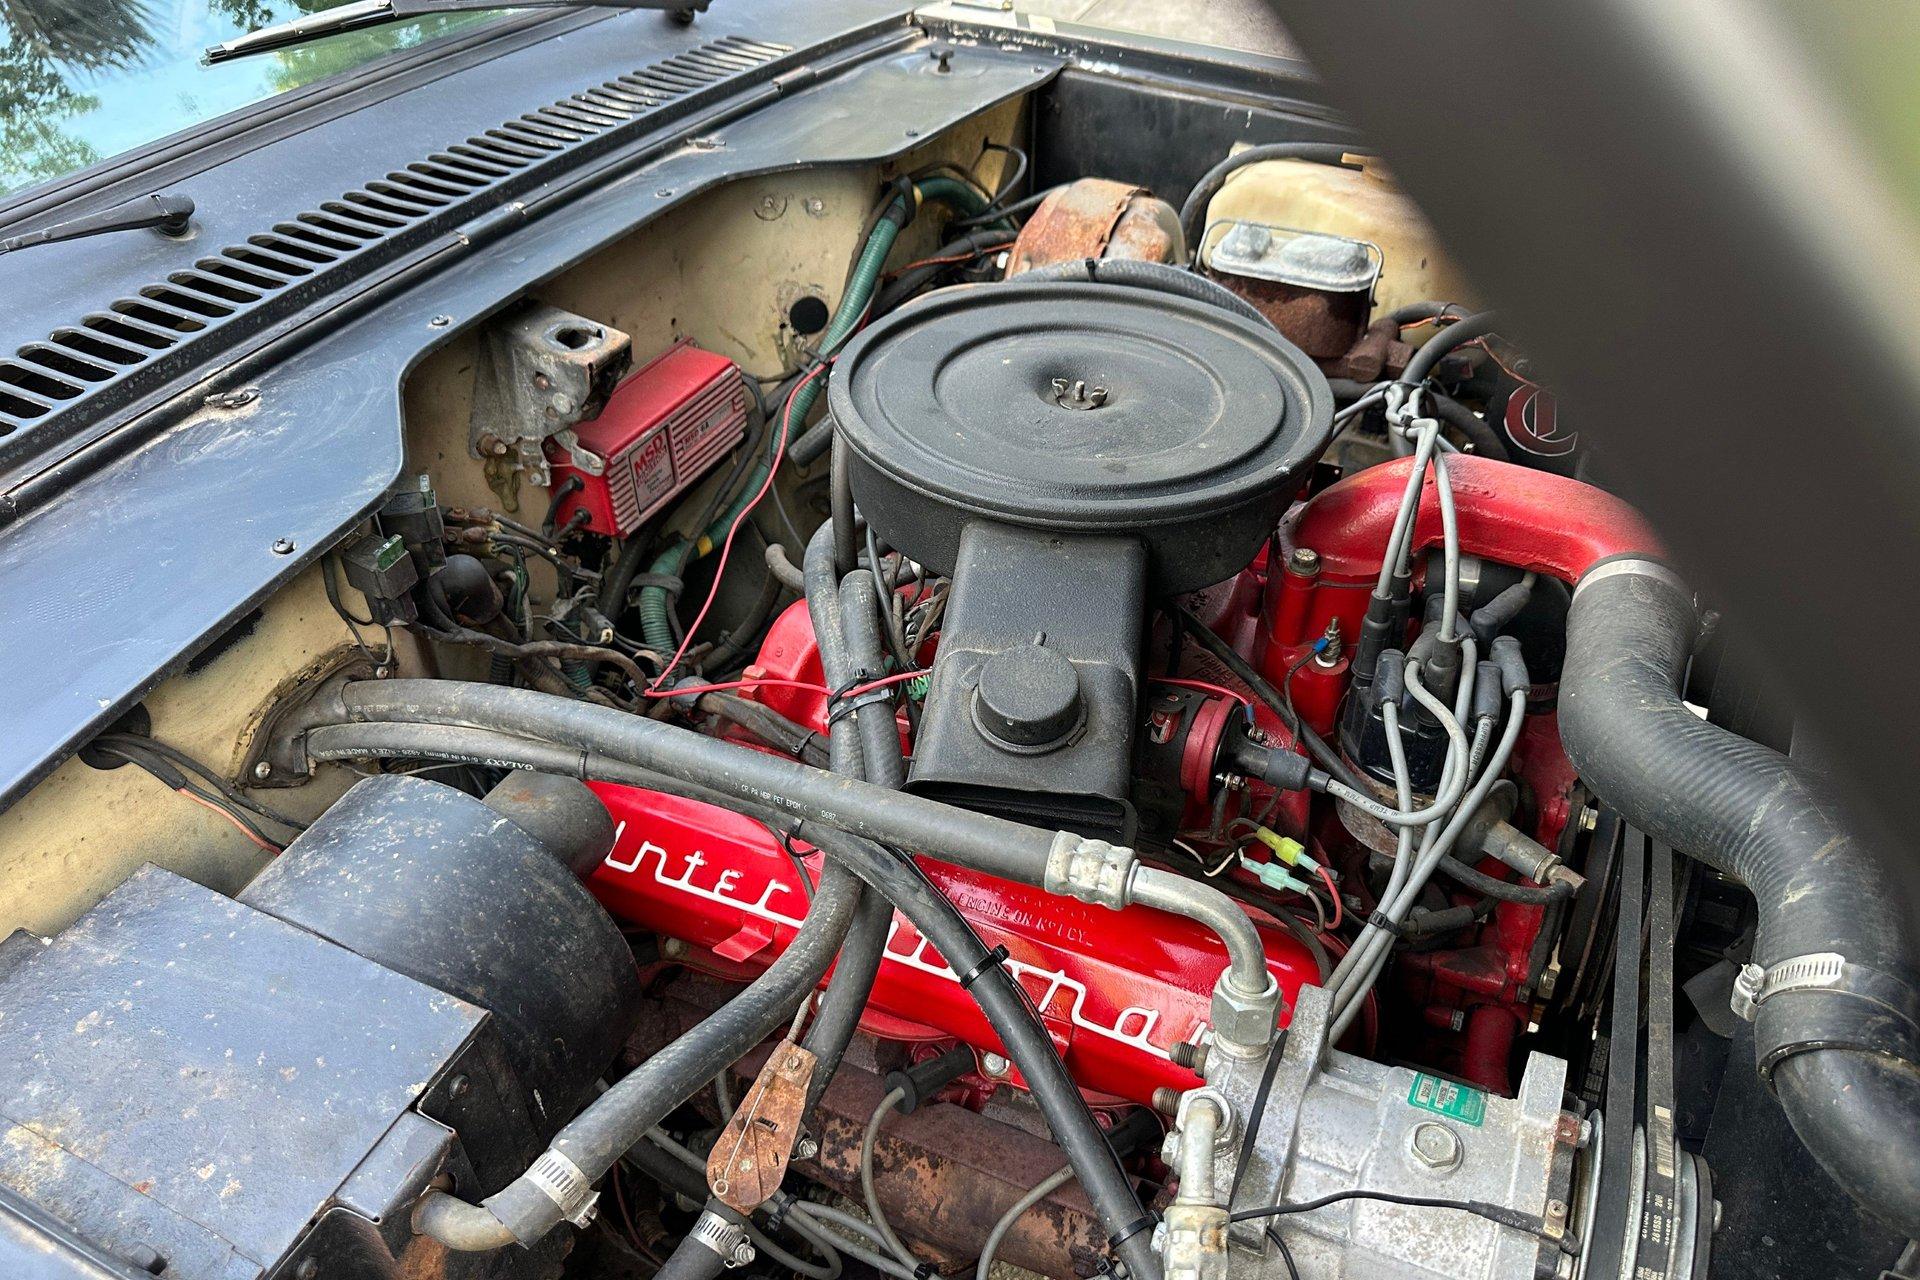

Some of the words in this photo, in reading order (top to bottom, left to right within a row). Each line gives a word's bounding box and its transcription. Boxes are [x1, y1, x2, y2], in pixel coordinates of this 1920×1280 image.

[634, 433, 664, 474] MSD
[347, 748, 369, 757] MADE
[483, 756, 534, 771] GALAXY
[771, 794, 784, 805] PET
[856, 820, 866, 830] 2
[1368, 800, 1388, 816] TEMP
[959, 892, 1010, 919] ENGINE
